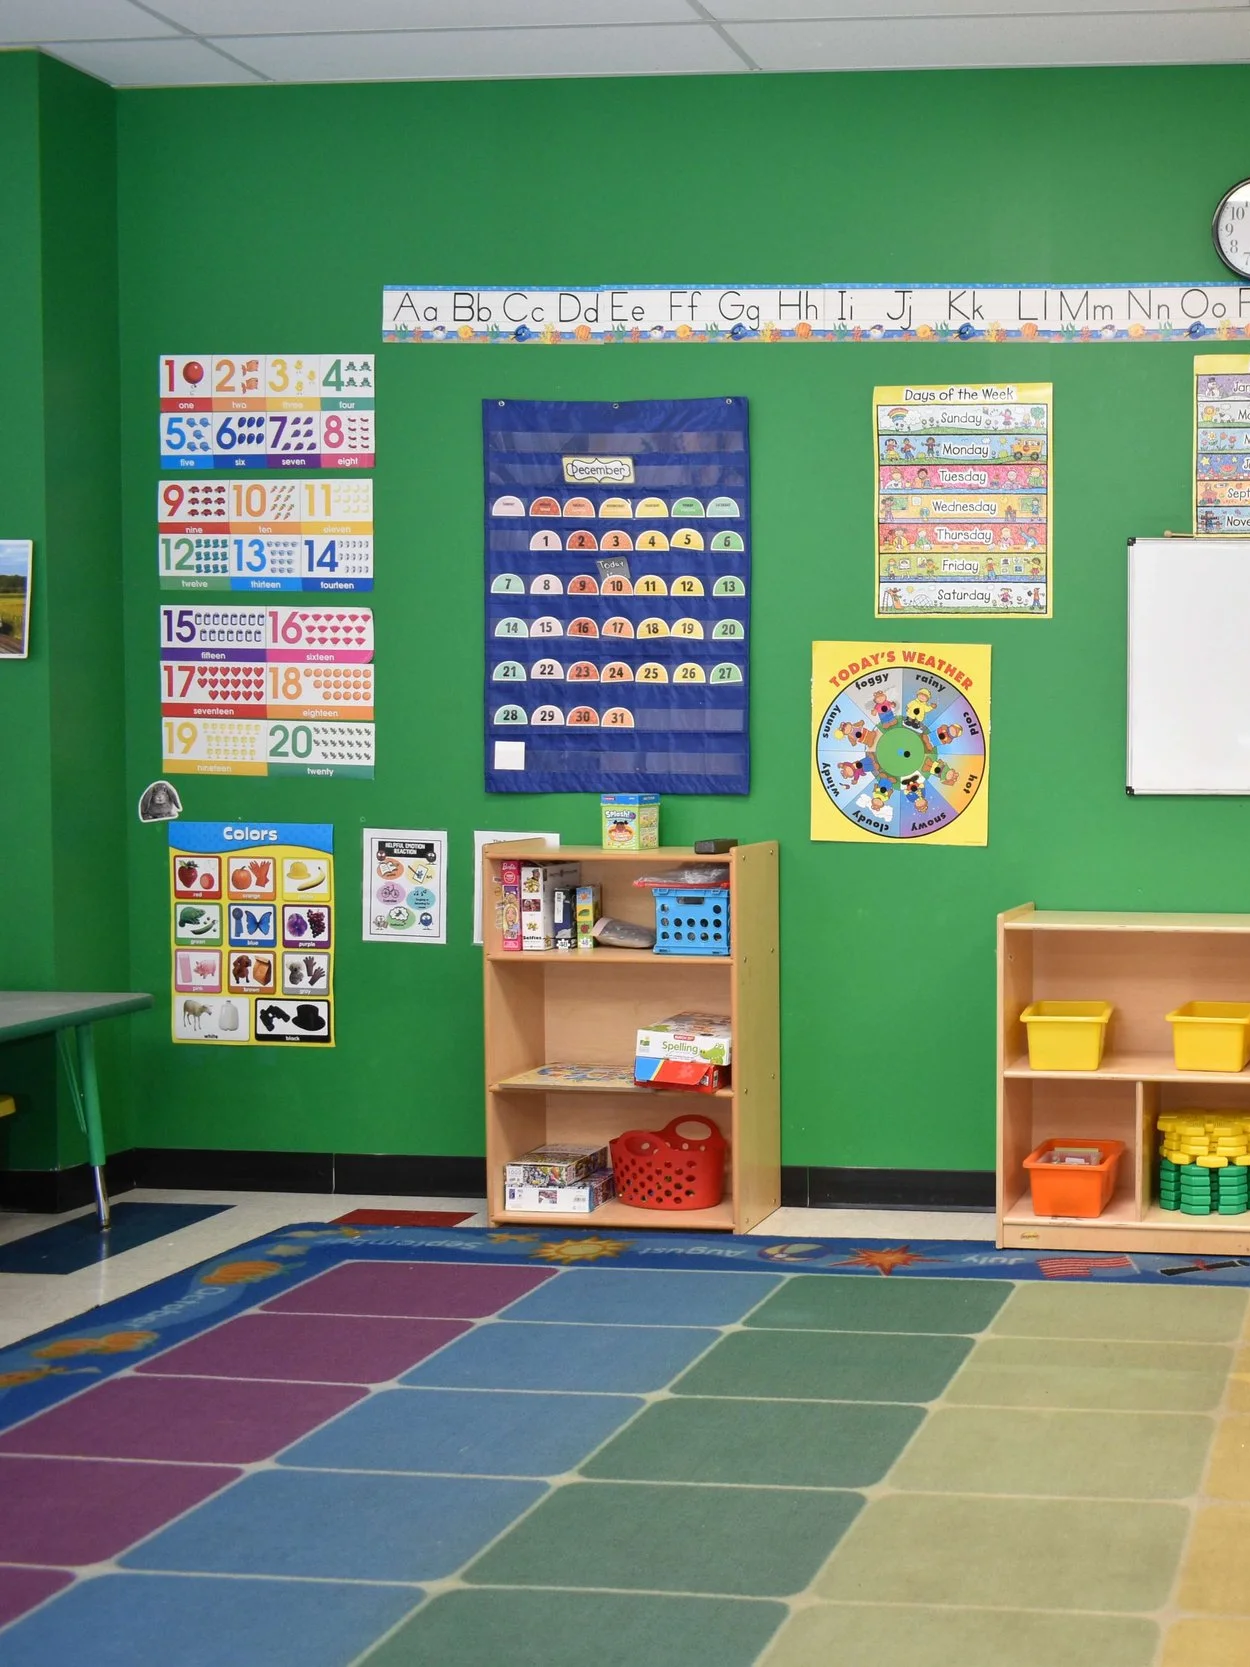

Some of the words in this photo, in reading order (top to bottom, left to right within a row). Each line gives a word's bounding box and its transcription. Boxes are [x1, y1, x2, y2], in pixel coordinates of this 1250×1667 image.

[1231, 206, 1245, 221] 10
[1225, 223, 1234, 237] 9
[1230, 239, 1238, 254] 8
[1243, 252, 1250, 266] 7
[393, 292, 438, 322] Aa
[453, 292, 492, 323] Bb
[503, 292, 545, 323] Cc
[558, 292, 599, 323] Dd
[611, 291, 645, 322] Ee
[669, 290, 702, 321] Ff
[718, 290, 760, 330] Gg
[778, 290, 818, 321] Hh
[837, 290, 853, 321] Ii
[886, 290, 913, 331] Jj
[948, 290, 985, 321] Kk
[1060, 290, 1113, 321] Mm
[1128, 289, 1170, 320] Nn
[1180, 288, 1227, 319] Oo
[215, 359, 236, 392] 2
[268, 358, 289, 392] 3
[322, 359, 345, 392] 4
[905, 389, 936, 403] Days
[939, 388, 954, 400] of
[958, 389, 978, 400] the
[982, 388, 1014, 399] Week
[165, 417, 186, 450] 5
[216, 416, 237, 450] 6
[269, 416, 288, 449] 7
[324, 415, 344, 449] 8
[941, 412, 982, 426] Sunday
[942, 443, 989, 458] Monday
[571, 465, 626, 477] December
[939, 471, 987, 485] Tuesday
[163, 484, 185, 517] 9
[232, 484, 267, 517] 10
[305, 484, 332, 517] 11
[932, 501, 997, 515] Wednesday
[936, 529, 992, 543] Thursday
[161, 538, 195, 571] 12
[233, 538, 267, 573] 13
[304, 539, 339, 573] 14
[942, 559, 979, 574] Friday
[937, 589, 991, 603] Saturday
[163, 610, 196, 643] 15
[268, 611, 303, 645] 16
[306, 653, 335, 661] sixteen
[829, 650, 896, 689] TODAY'S
[902, 650, 974, 691] WEATHER
[164, 665, 196, 698] 17
[269, 667, 302, 700] 18
[855, 672, 889, 691] foggy
[915, 674, 947, 693] rainy
[193, 707, 234, 716] seventeen
[822, 704, 842, 739] sunny
[963, 711, 980, 736] cold
[164, 721, 198, 755] 19
[269, 724, 313, 758] 20
[822, 762, 841, 798] windy
[962, 774, 978, 795] hot
[222, 826, 278, 842] Colors
[852, 810, 890, 833] cloudy
[910, 812, 947, 832] snowy
[662, 1041, 699, 1055] Spelling
